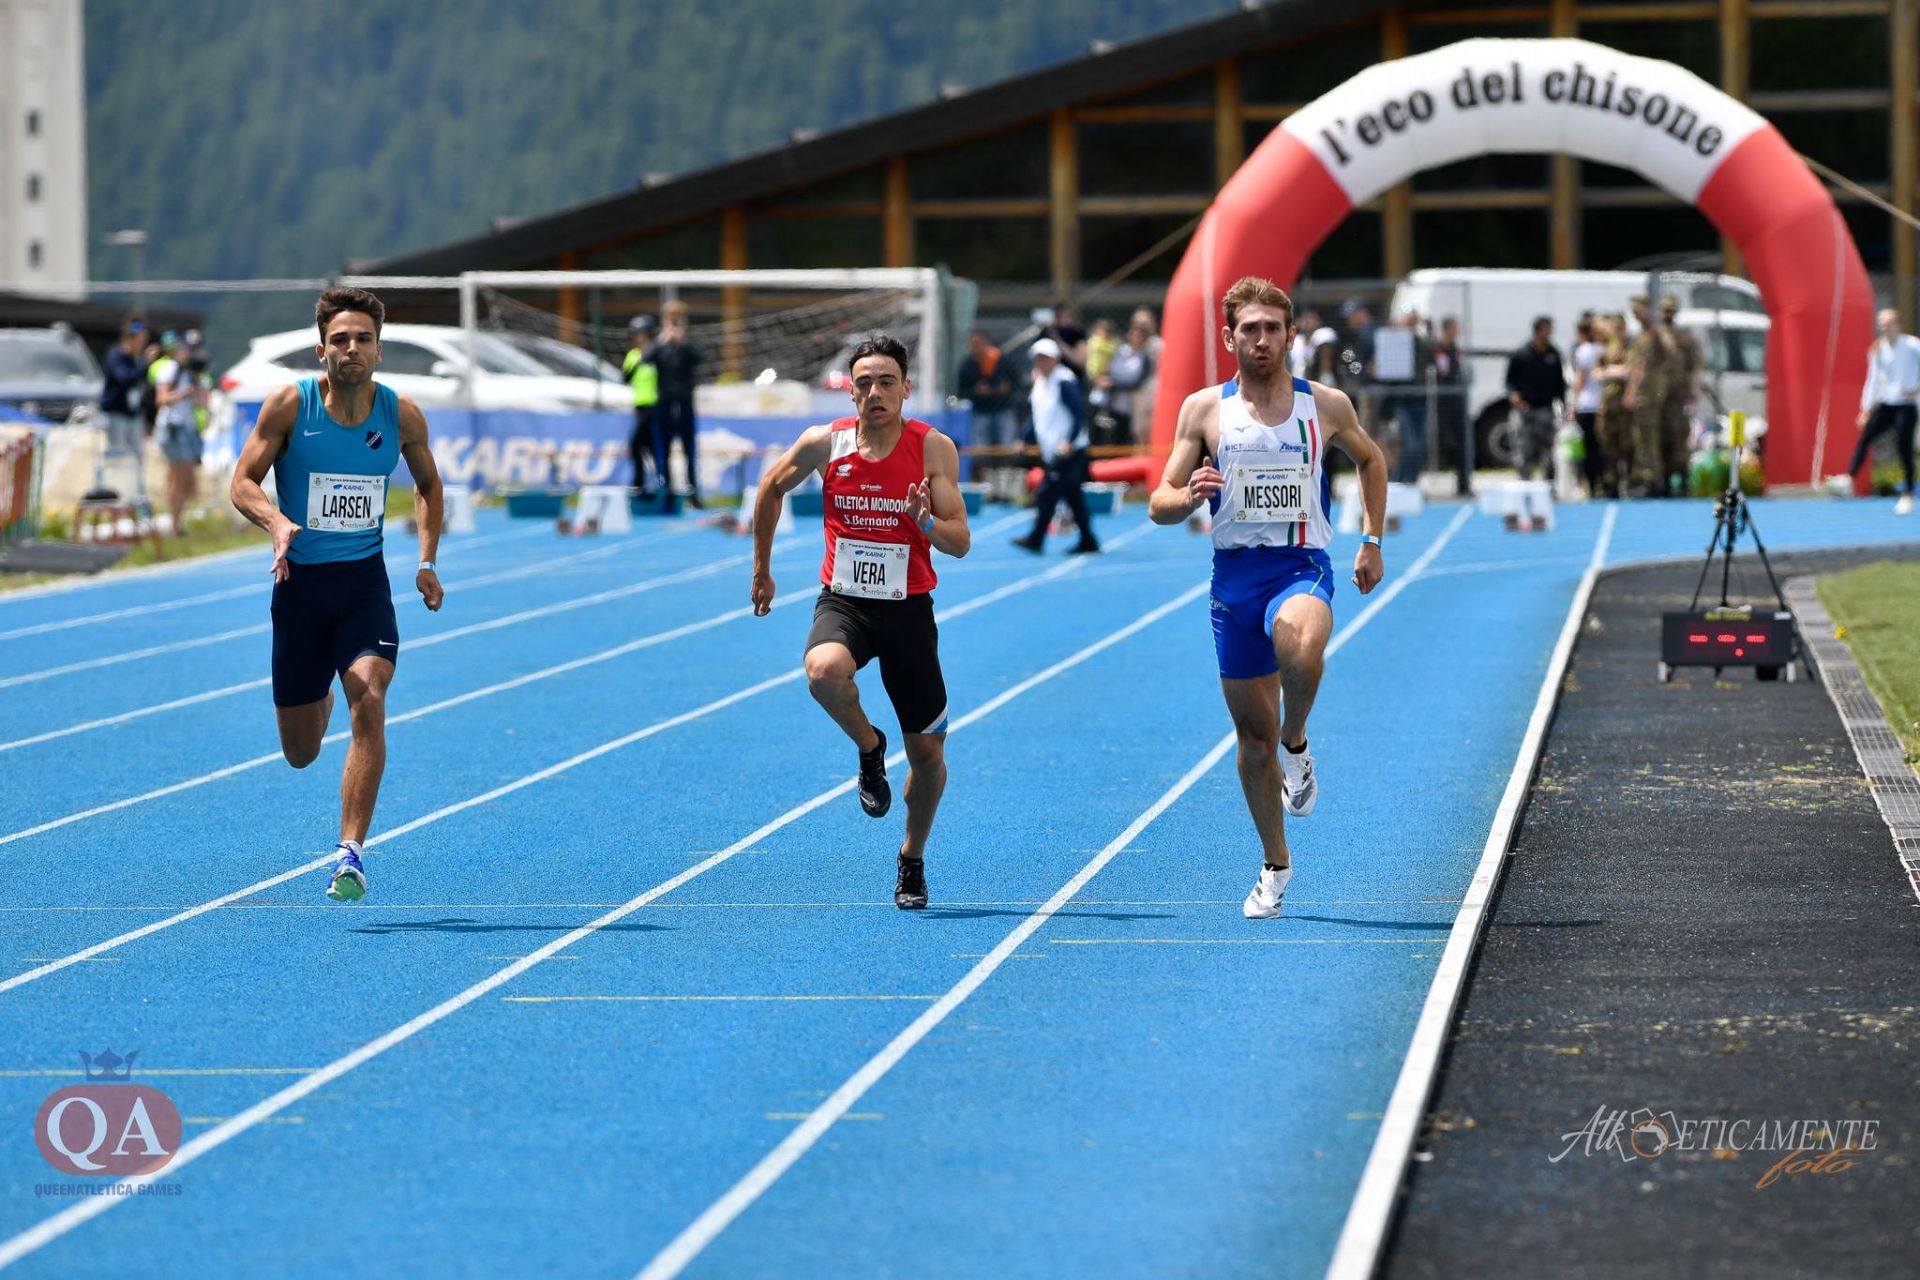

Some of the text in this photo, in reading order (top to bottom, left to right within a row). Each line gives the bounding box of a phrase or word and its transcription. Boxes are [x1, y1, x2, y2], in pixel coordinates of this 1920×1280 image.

[1321, 62, 1724, 168] l'eco del chisone
[431, 435, 626, 485] KARHU
[322, 494, 371, 518] LARSEN
[834, 494, 869, 511] ATLETICA
[1244, 485, 1302, 509] MESSORI
[844, 514, 899, 527] S.Bernardo
[853, 560, 886, 586] VERA
